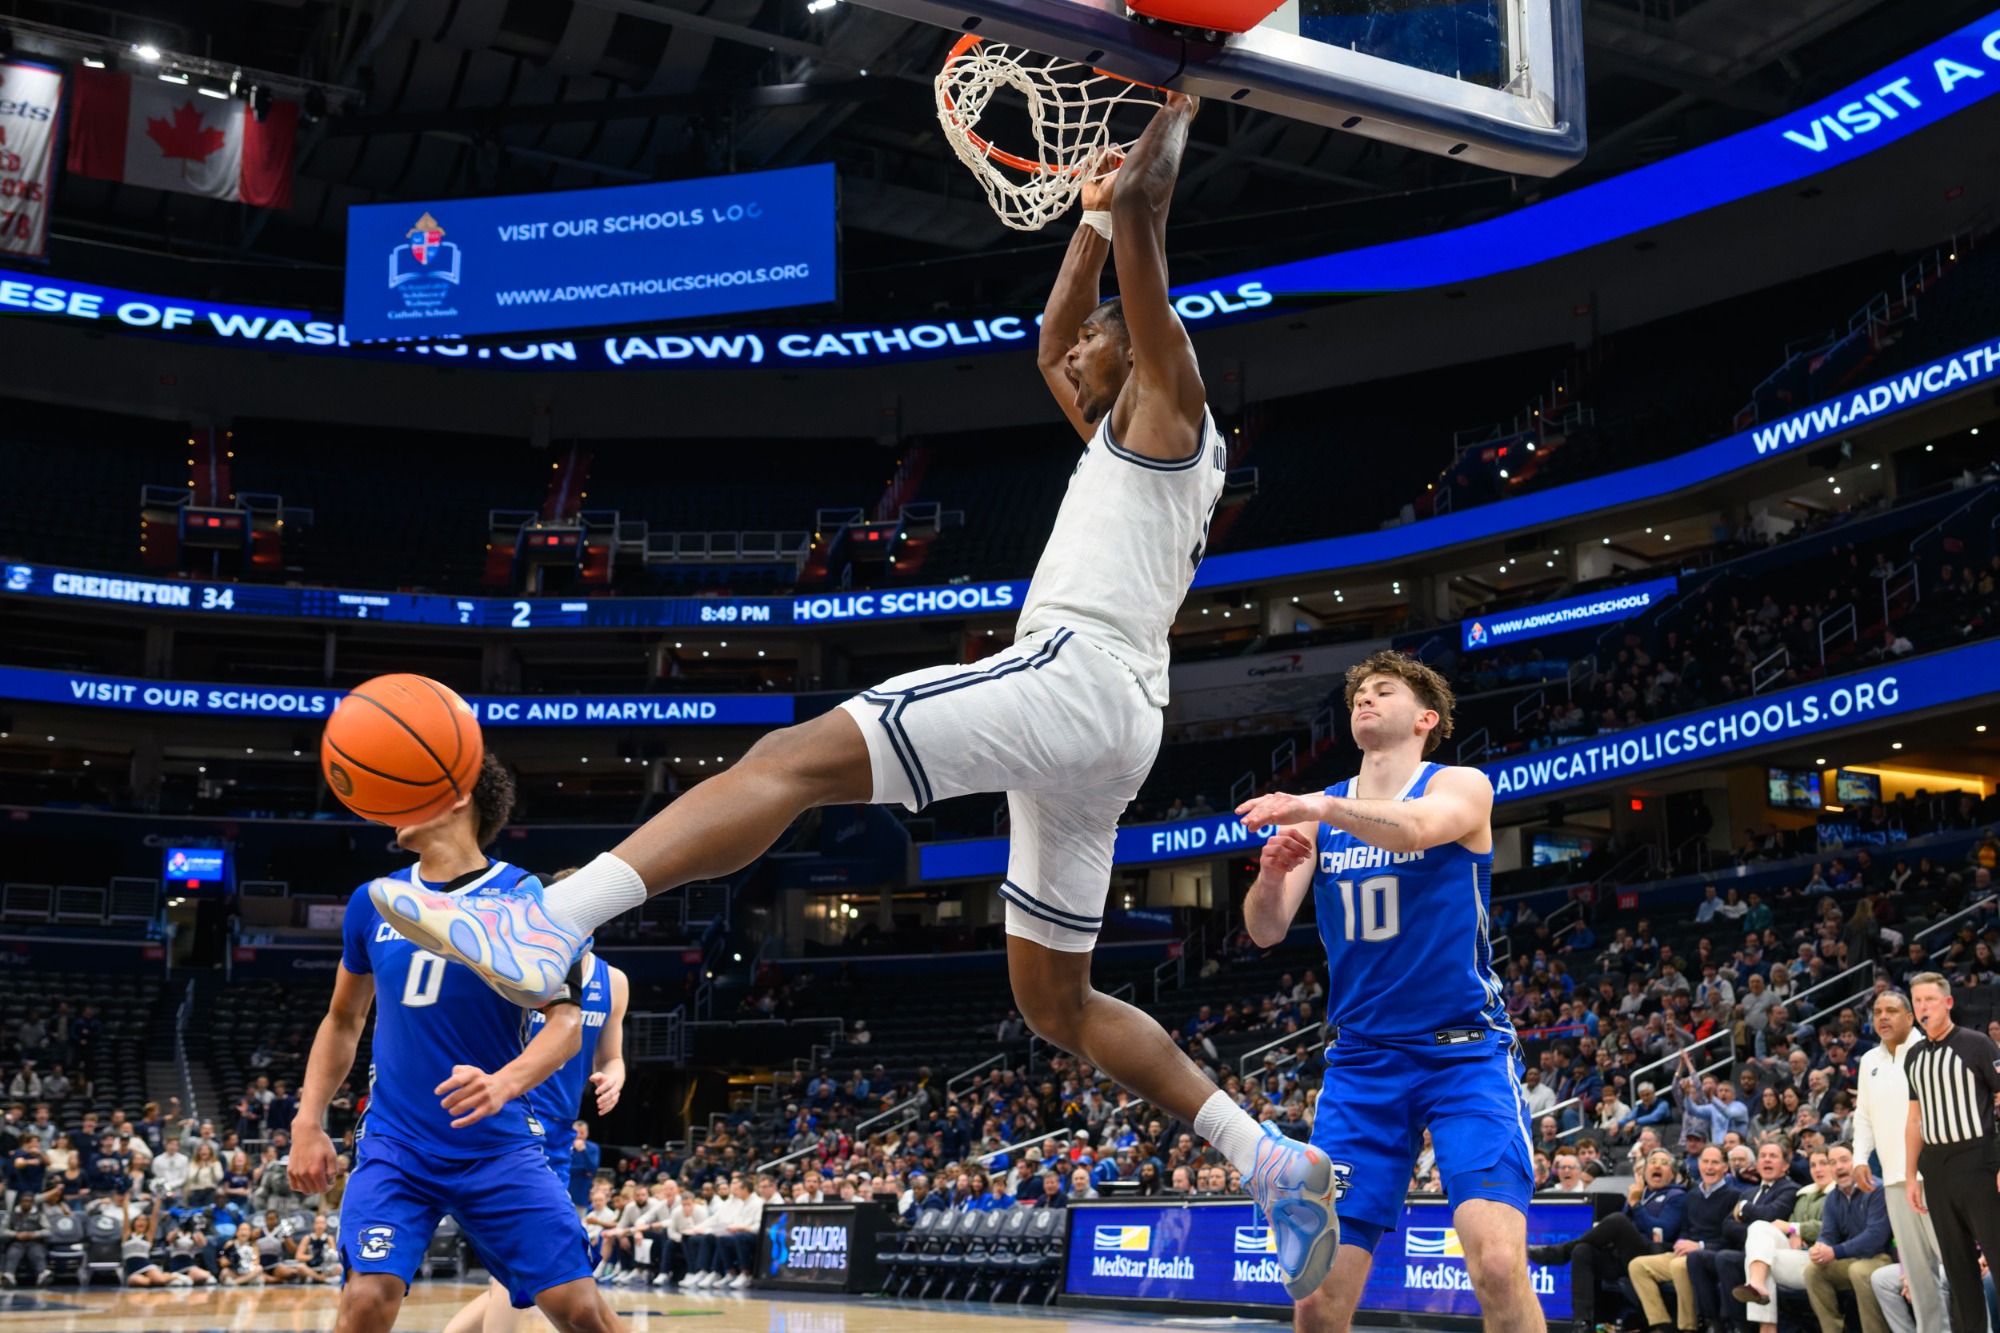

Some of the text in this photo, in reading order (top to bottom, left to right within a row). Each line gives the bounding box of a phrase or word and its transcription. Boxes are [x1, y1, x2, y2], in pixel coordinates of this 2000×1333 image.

[1782, 57, 1985, 152] VISIT A
[498, 222, 549, 242] VISIT
[552, 218, 599, 238] OUR
[603, 208, 704, 234] SCHOOLS
[496, 262, 810, 306] WWW.ADWCATHOLICSCHOOLS.ORG
[0, 280, 104, 318] ESE
[117, 302, 195, 329] OF
[604, 334, 764, 365] (ADW)
[778, 316, 1026, 358] CATHOLIC
[53, 572, 235, 610] CREIGHTON 34
[793, 586, 1013, 620] HOLIC SCHOOLS
[357, 606, 368, 618] 2
[459, 611, 470, 623] 2
[511, 601, 531, 628] 2
[701, 605, 770, 622] 8:49 PM
[1491, 593, 1650, 636] WWW.ADWCATHOLICSCHOOLS
[70, 680, 137, 703] VISIT
[143, 687, 200, 708] OUR
[207, 691, 325, 713] SCHOOLS
[487, 703, 520, 720] DC
[527, 703, 578, 720] AND
[586, 702, 717, 719] MARYLAND
[1483, 677, 1900, 797] ADWCATHOLICSCHOOLS.ORG
[1152, 826, 1207, 853] FIND
[1213, 821, 1248, 846] AN
[1320, 845, 1425, 874] CRIGHTON
[1337, 875, 1400, 942] 10
[401, 949, 447, 1008] 0
[790, 1226, 847, 1254] SQUADRA
[787, 1252, 847, 1270] SOLUTIONS
[1092, 1254, 1194, 1280] MedStar Health
[1233, 1258, 1282, 1284] MedSt
[1405, 1263, 1475, 1291] MedSta
